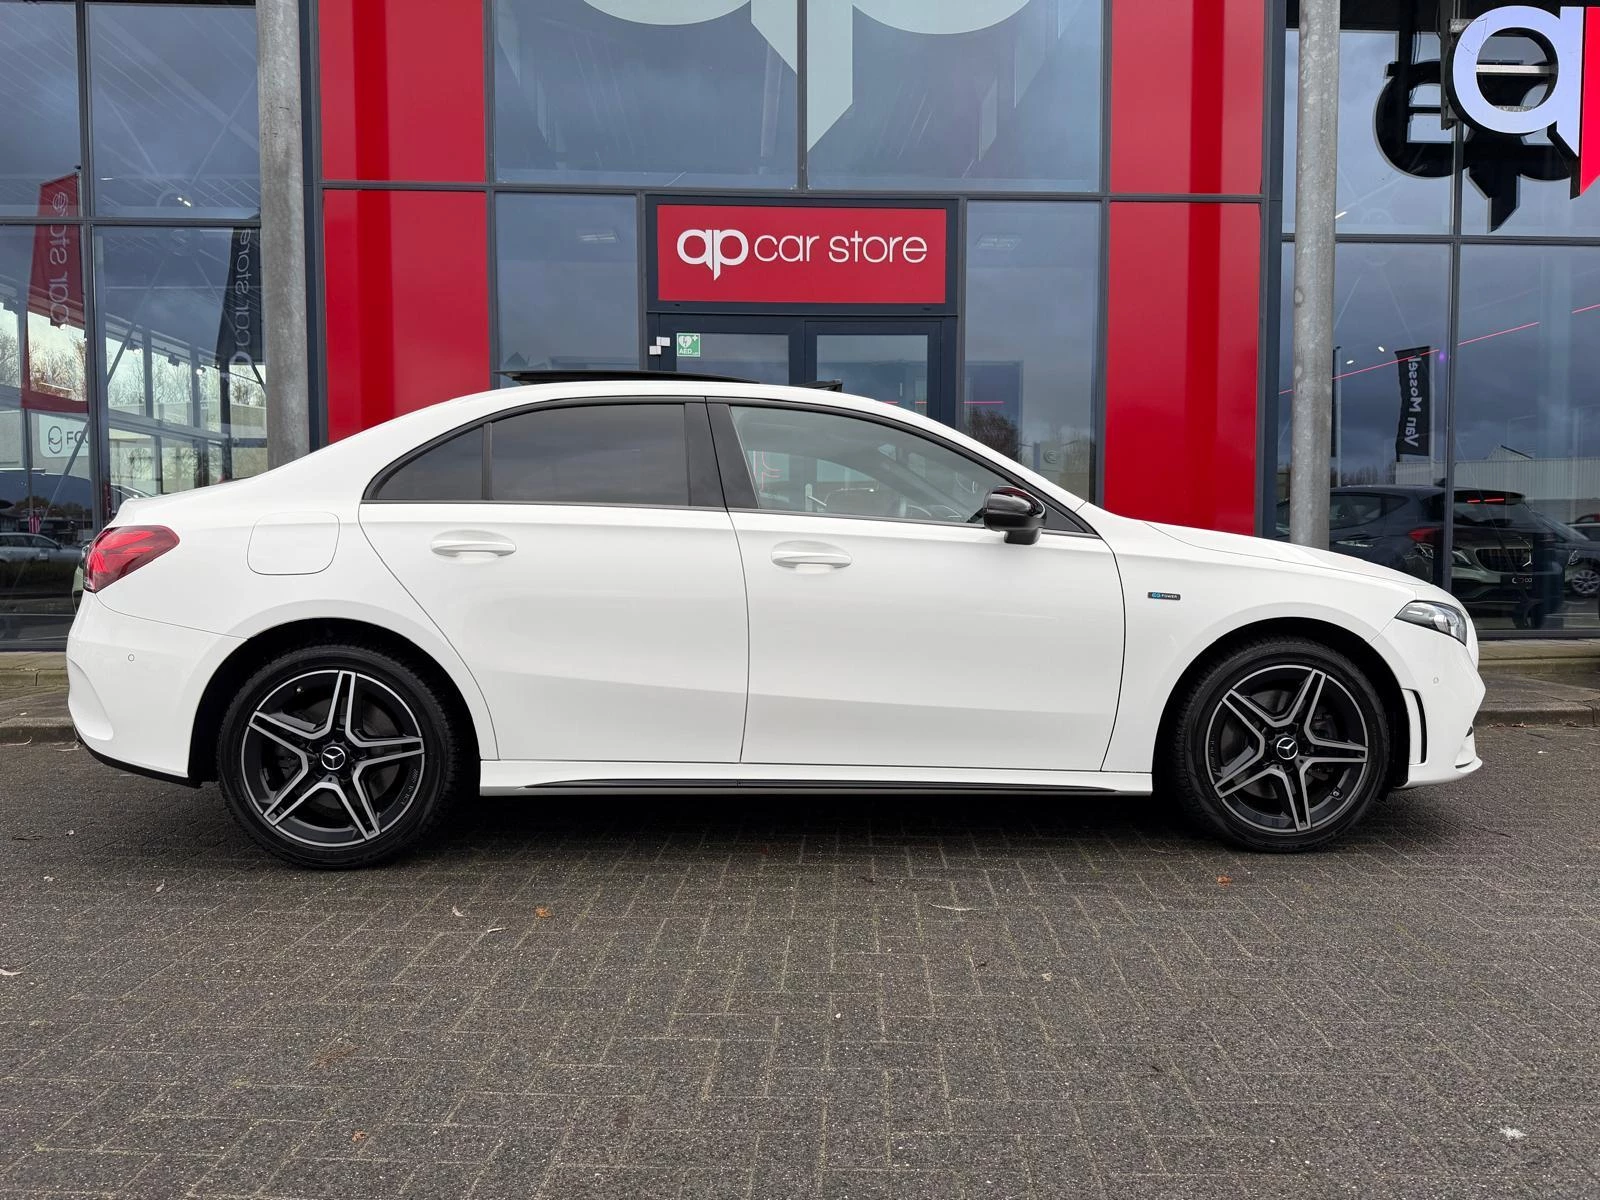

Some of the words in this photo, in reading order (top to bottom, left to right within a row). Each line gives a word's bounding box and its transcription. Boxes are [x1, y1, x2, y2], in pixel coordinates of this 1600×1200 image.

[676, 229, 749, 280] ap
[754, 234, 820, 262] car
[828, 230, 928, 263] store
